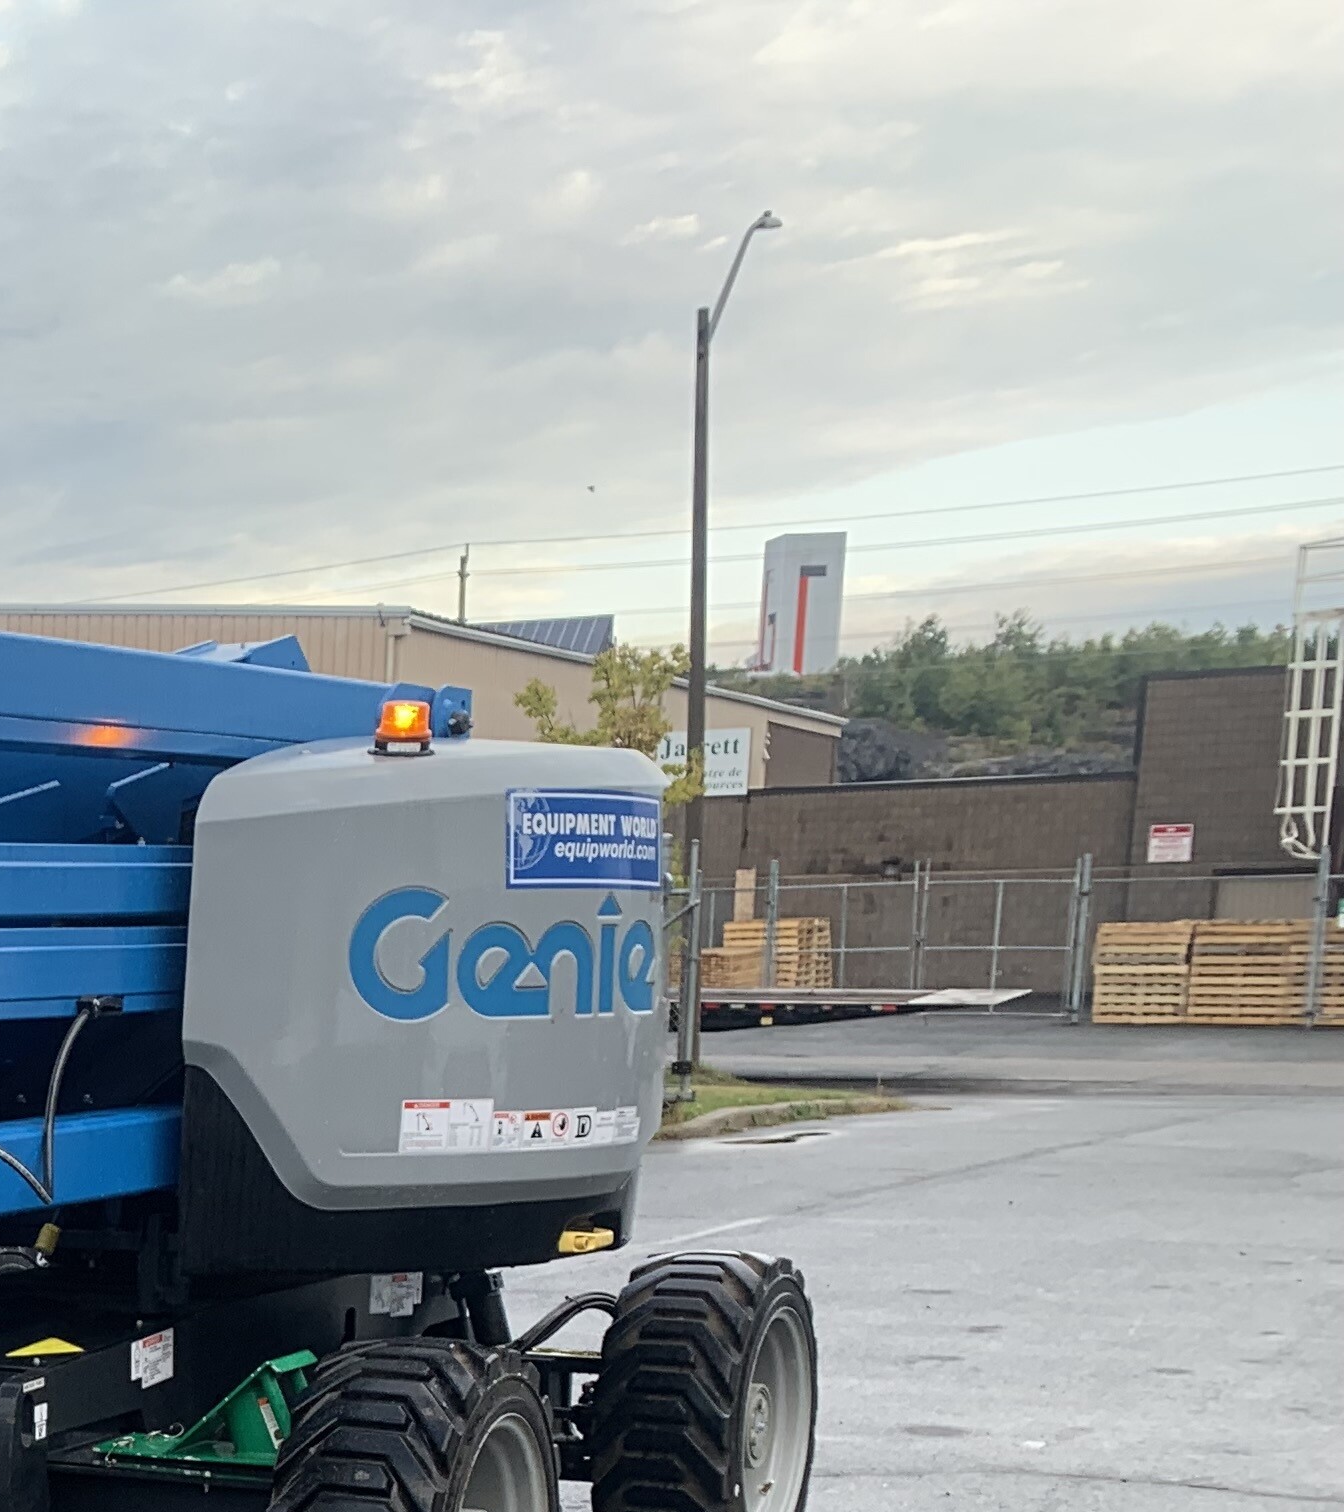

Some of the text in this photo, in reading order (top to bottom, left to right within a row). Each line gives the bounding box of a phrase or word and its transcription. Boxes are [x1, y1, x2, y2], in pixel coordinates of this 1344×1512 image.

[522, 812, 657, 840] EQUIPMENT WORLD
[554, 837, 657, 863] equipworld.com
[349, 886, 657, 1023] Genie
